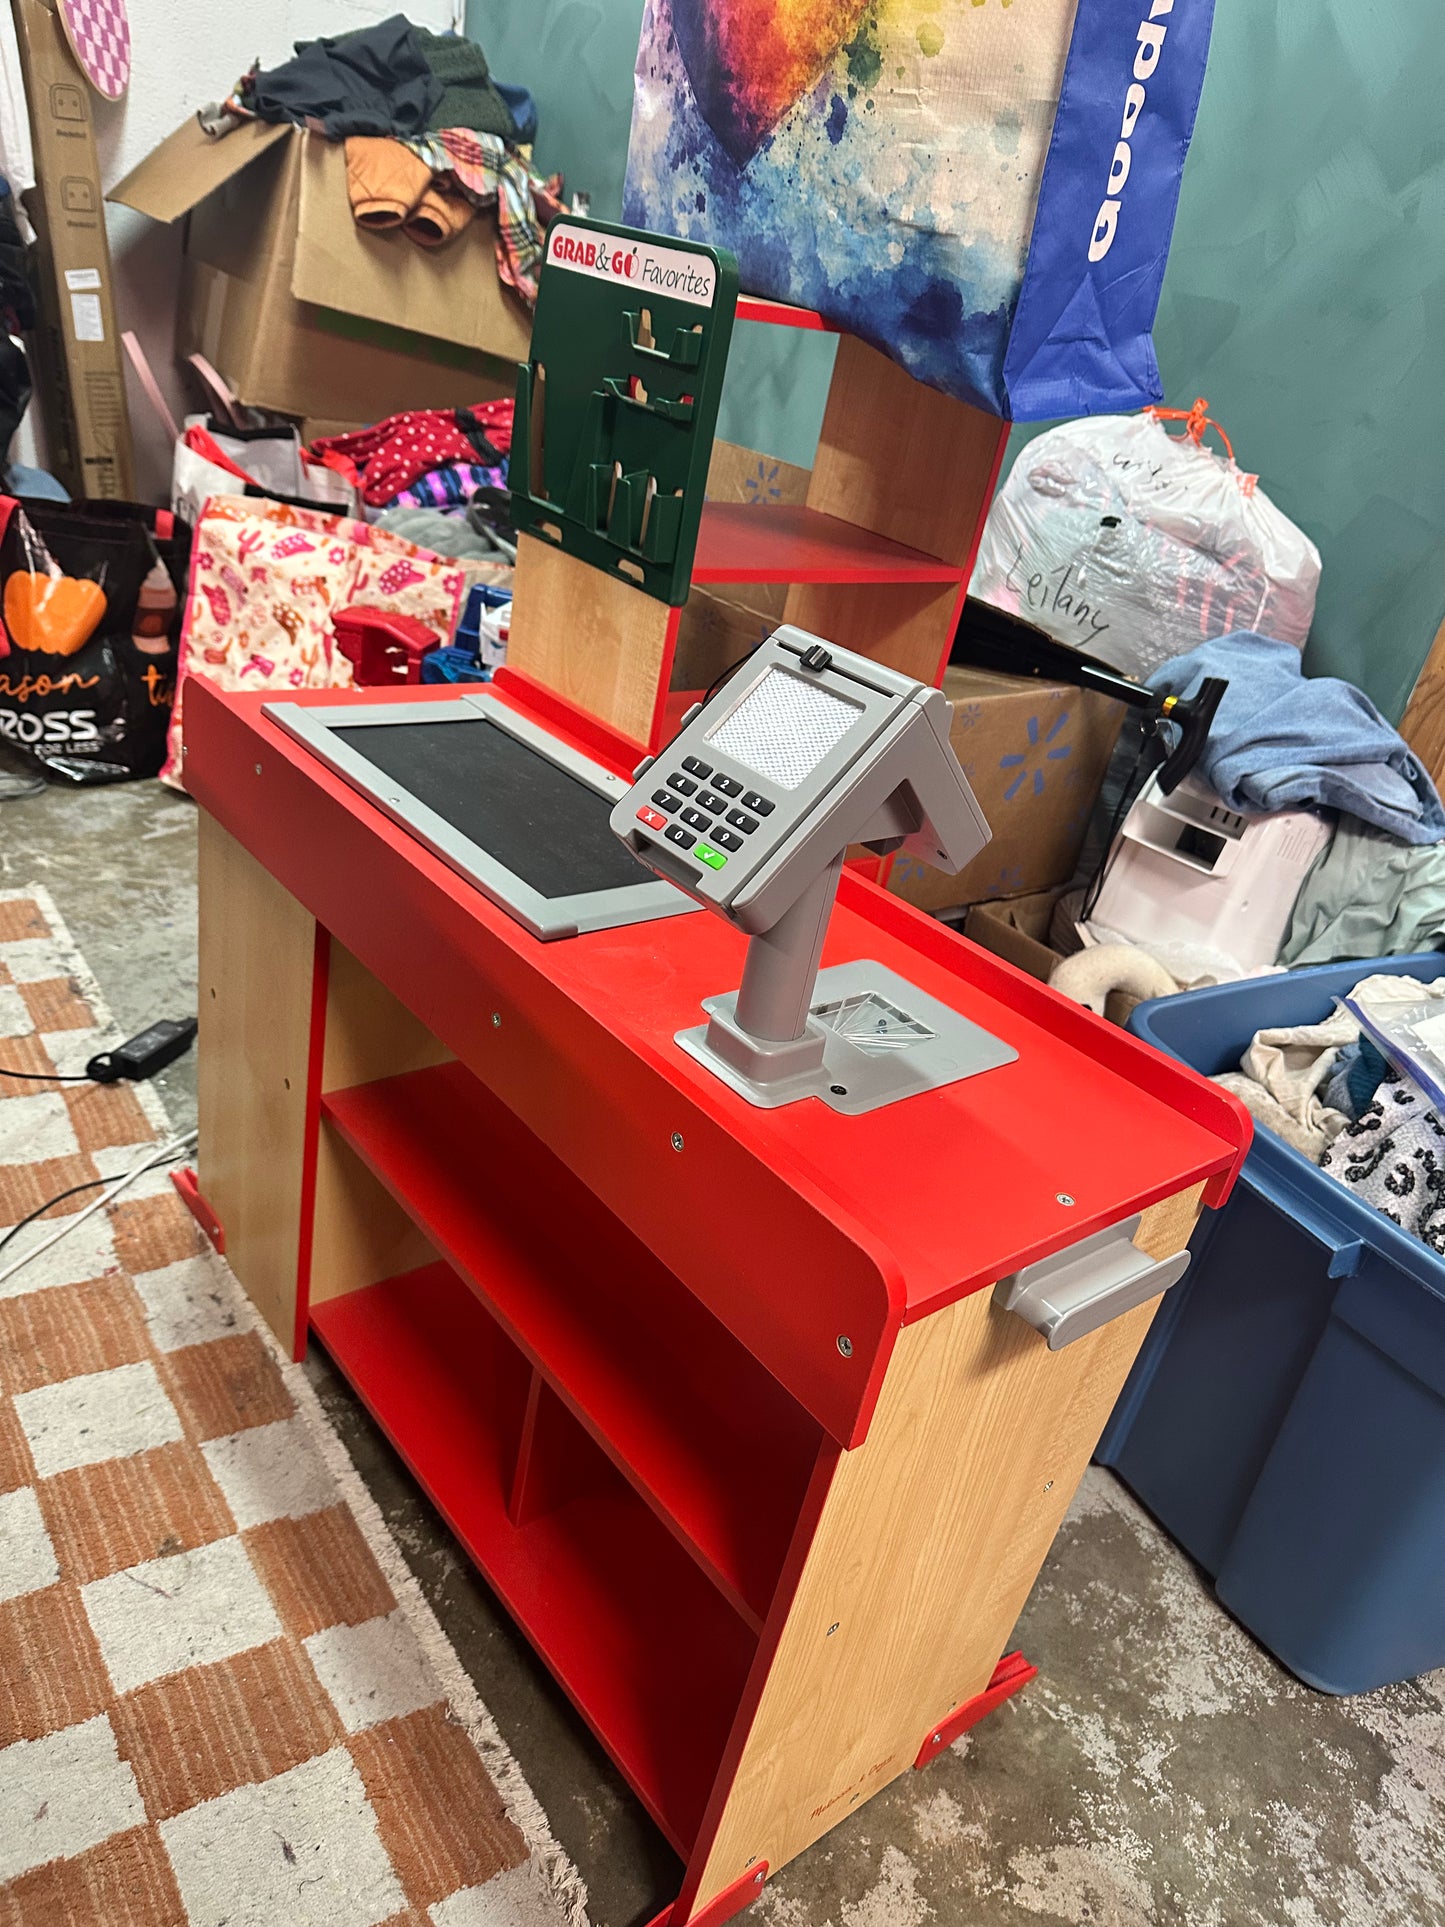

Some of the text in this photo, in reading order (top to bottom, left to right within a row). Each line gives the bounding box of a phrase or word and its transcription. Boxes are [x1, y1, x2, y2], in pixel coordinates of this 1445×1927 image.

[642, 258, 711, 297] Favorites
[0, 708, 98, 742] ROSS
[676, 778, 746, 825] 4 5 6
[720, 779, 730, 789] 2
[751, 797, 762, 808] 3
[660, 794, 730, 842] 7 8 9
